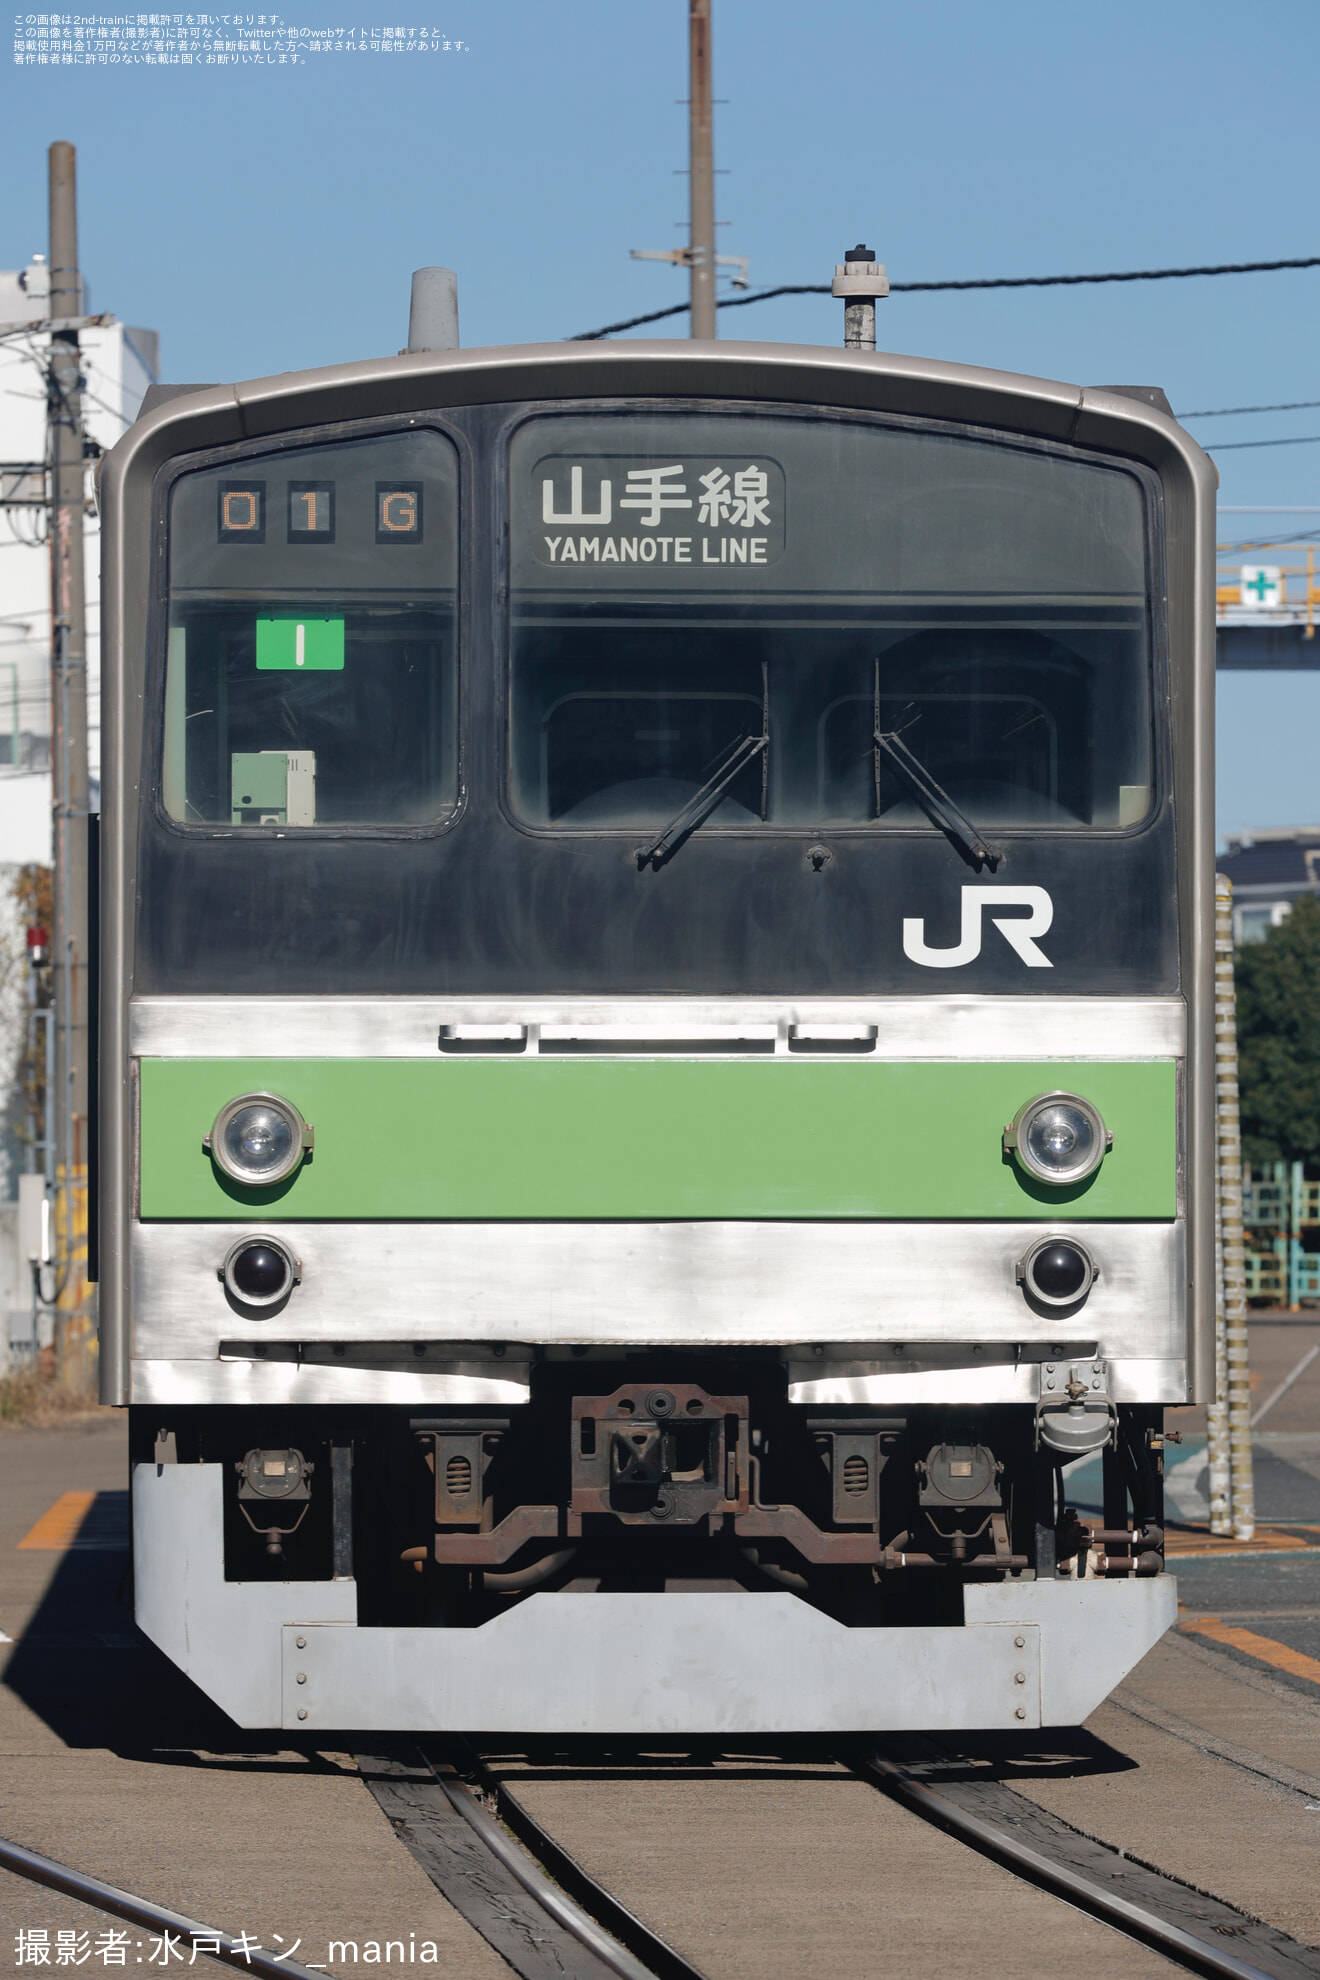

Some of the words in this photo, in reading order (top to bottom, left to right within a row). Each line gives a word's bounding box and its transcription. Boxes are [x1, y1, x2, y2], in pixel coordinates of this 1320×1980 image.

[541, 463, 773, 529] 山手線
[543, 535, 693, 564] YAMANOTE
[702, 535, 769, 564] LINE
[902, 884, 1055, 969] JR
